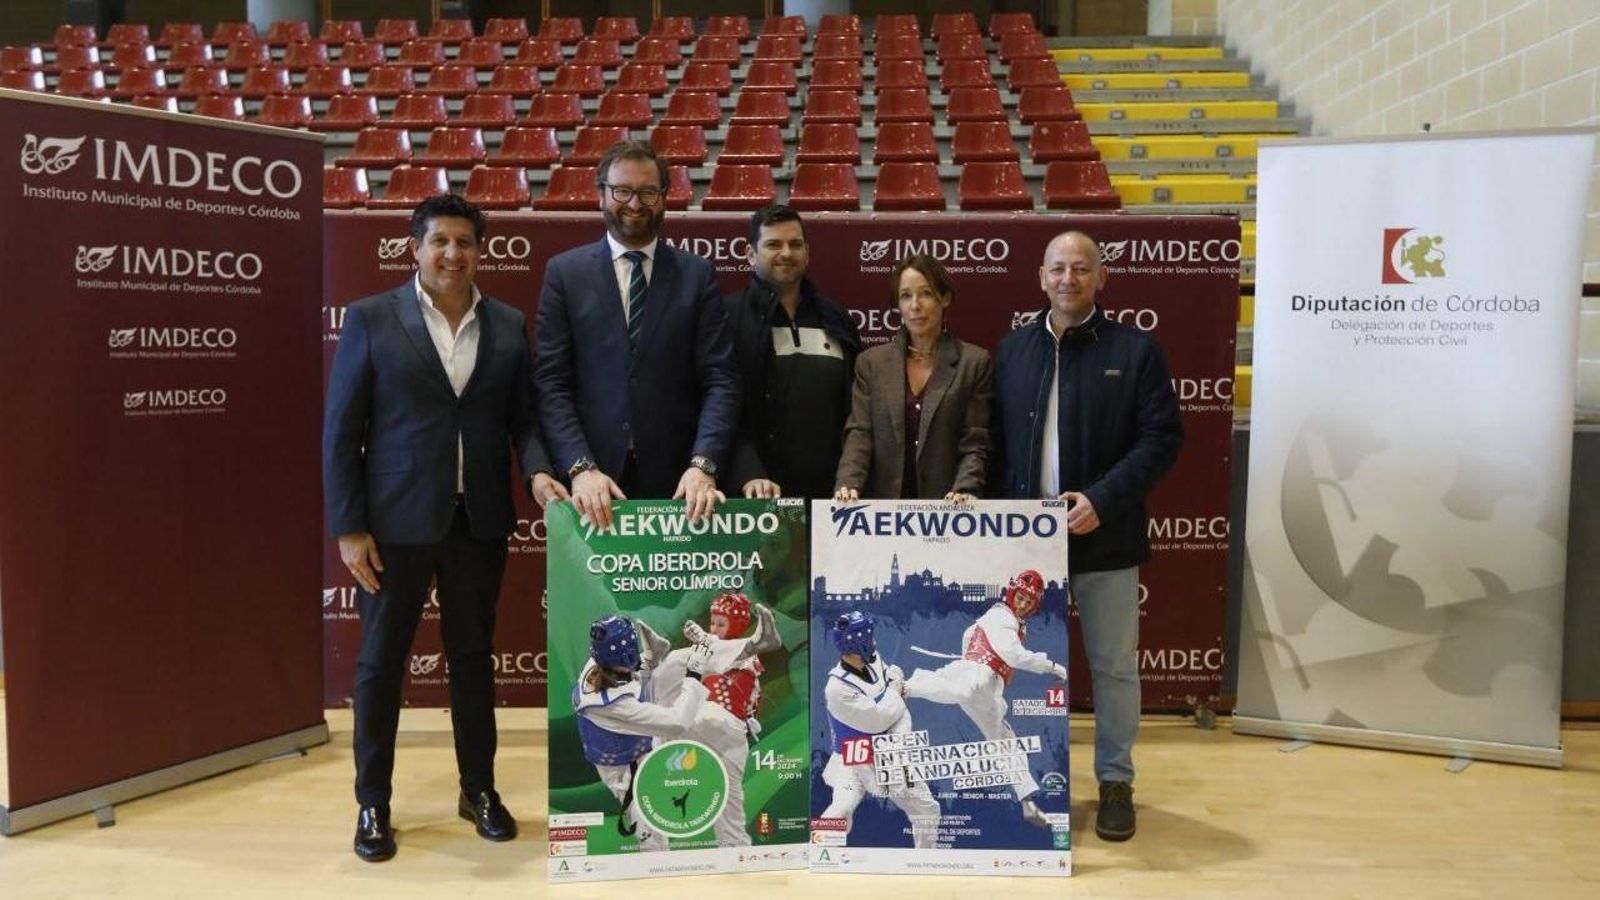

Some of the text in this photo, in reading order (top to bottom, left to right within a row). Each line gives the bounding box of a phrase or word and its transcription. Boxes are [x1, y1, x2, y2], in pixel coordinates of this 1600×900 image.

[94, 138, 302, 199] IMDECO
[23, 184, 301, 220] Instituto Municipal de Deportes Córdoba
[895, 238, 1010, 261] IMDECO
[1131, 240, 1241, 261] IMDECO
[123, 246, 263, 280] IMDECO
[77, 279, 119, 290] Instituto
[120, 280, 168, 293] Municipal
[169, 281, 182, 292] de
[183, 282, 224, 295] Deportes
[1291, 293, 1540, 315] Diputación de Córdoba
[1331, 318, 1494, 334] Delegación de Deportes
[140, 328, 237, 348] IMDECO
[1354, 334, 1468, 349] y Protección Civil
[149, 388, 226, 407] IMDECO
[587, 551, 764, 574] COPA IBERDROLA
[612, 573, 744, 592] SENIOR OLÍMPICO
[1048, 689, 1064, 705] 14
[874, 731, 929, 749] OPEN
[751, 750, 777, 770] 14
[843, 739, 870, 764] 16
[876, 737, 1040, 767] INTERNACIONAL
[664, 778, 698, 787] Iberdrola
